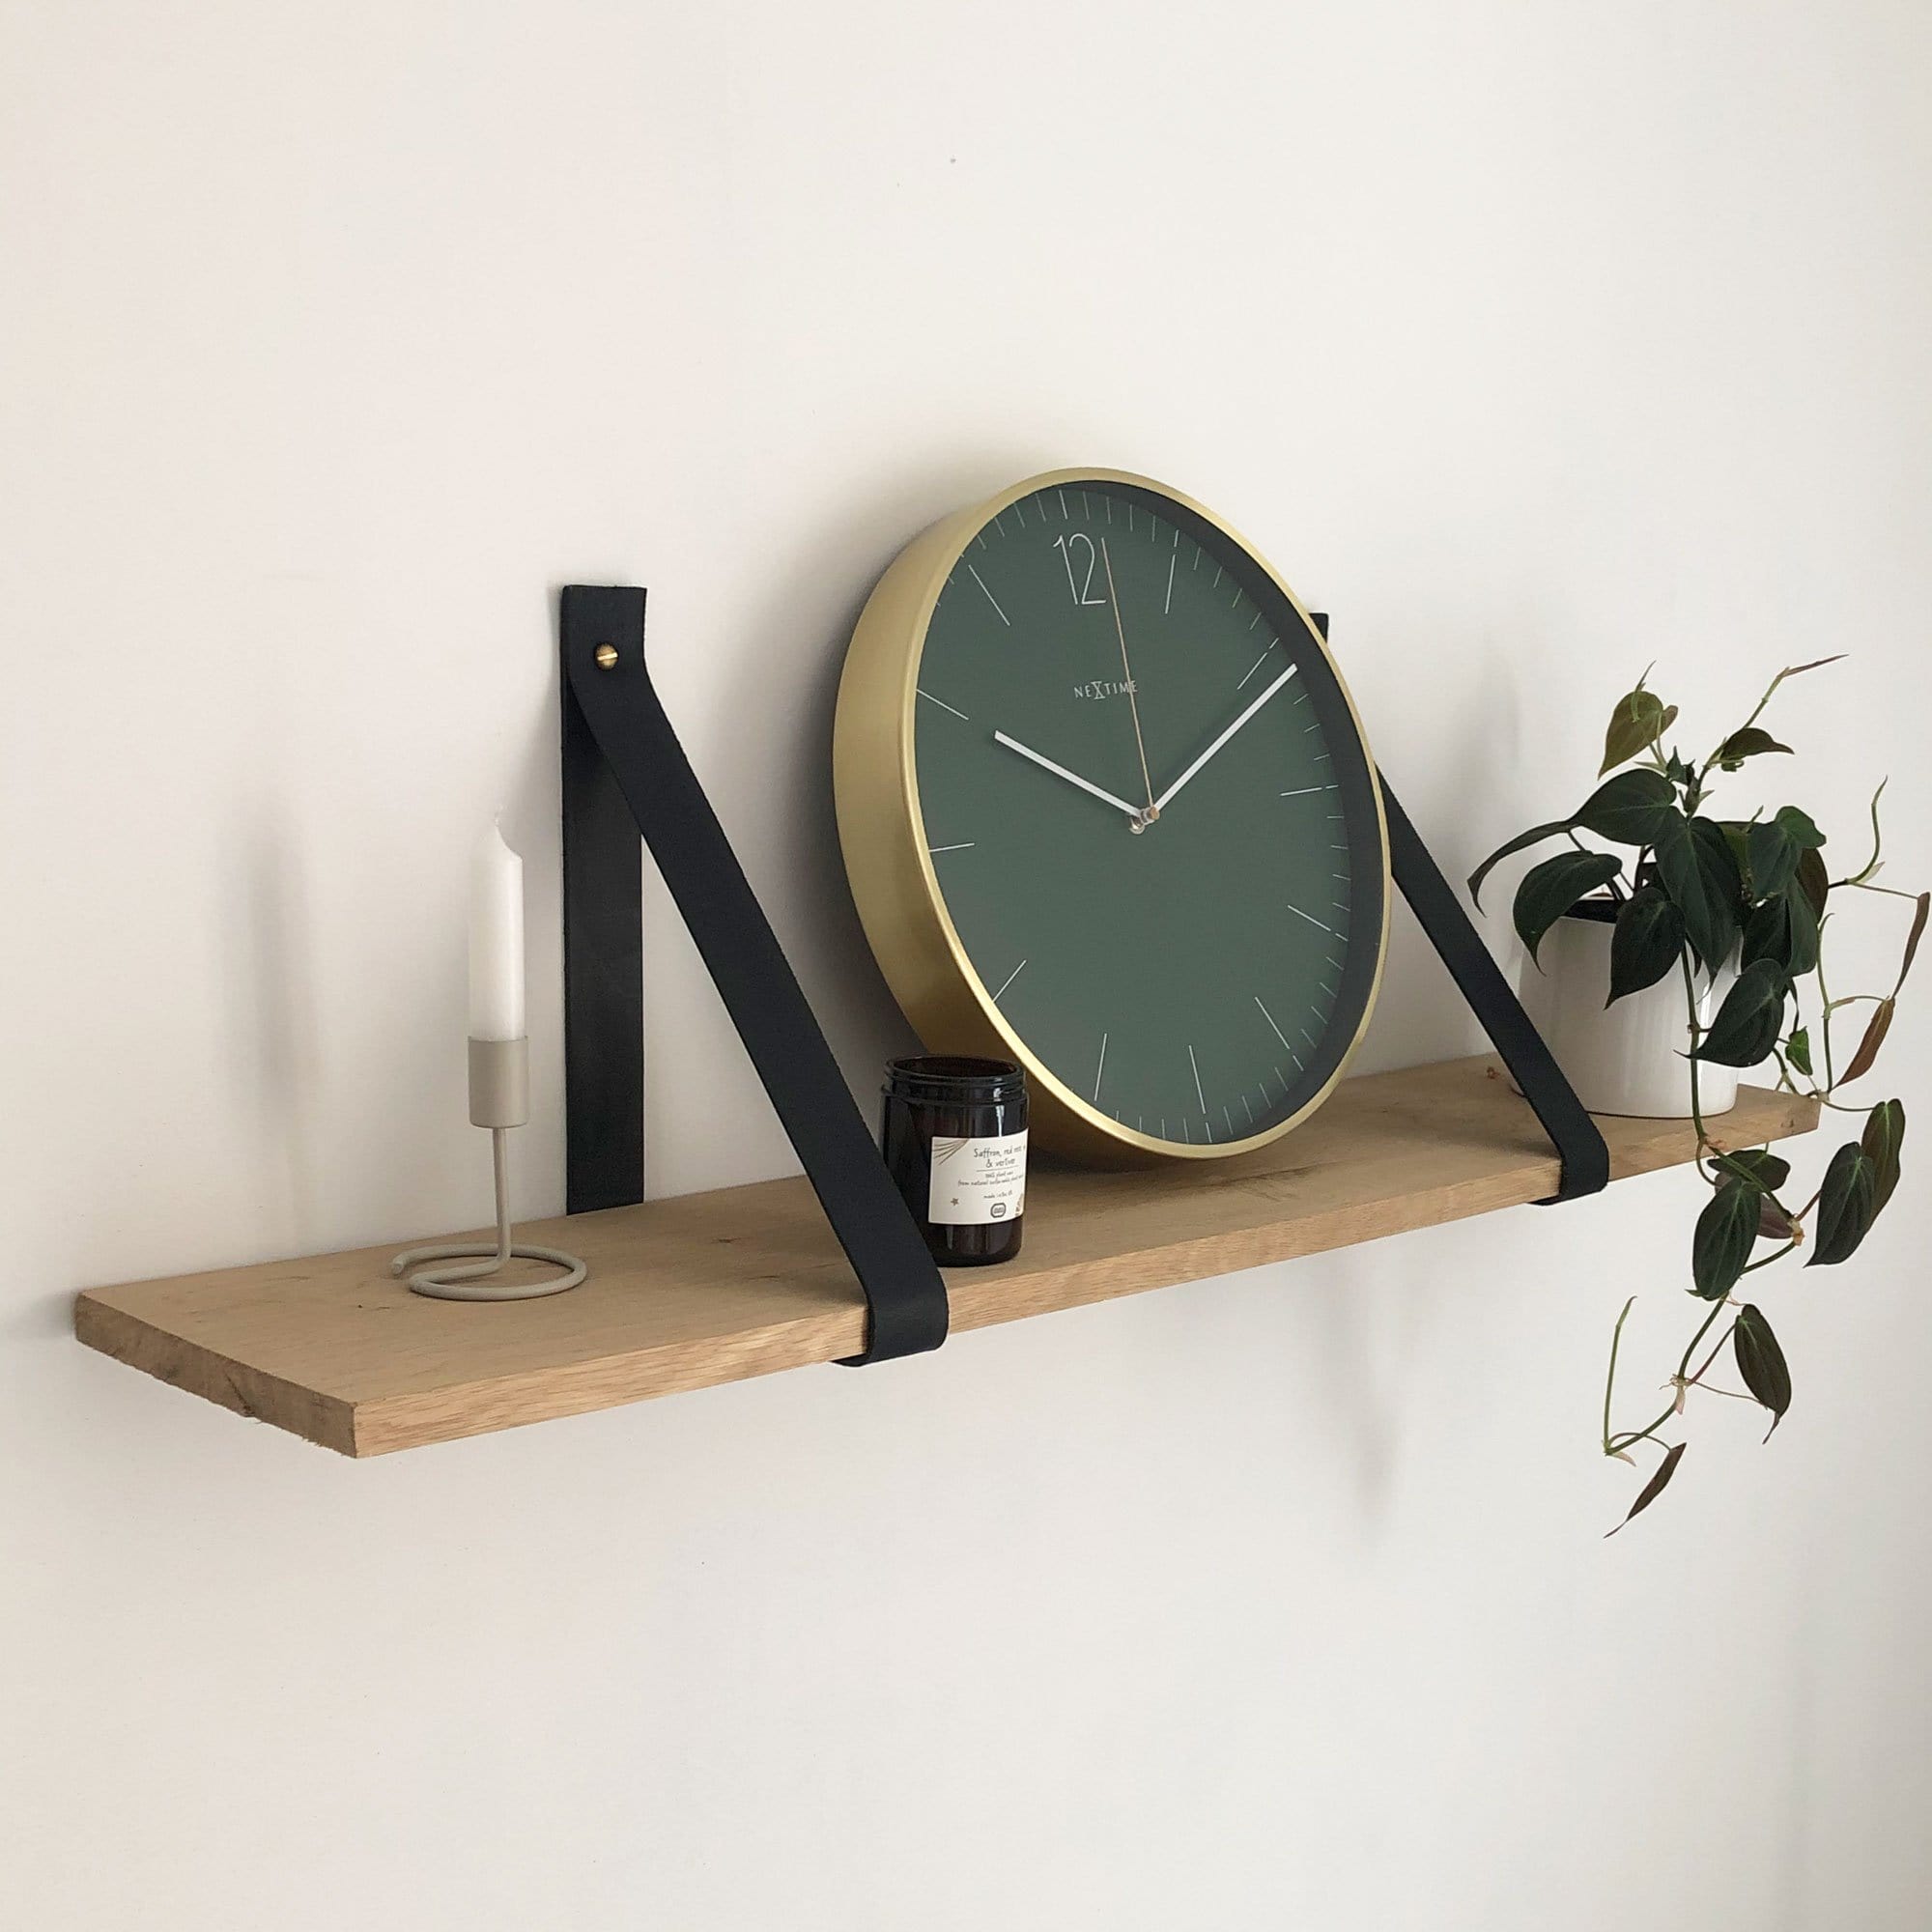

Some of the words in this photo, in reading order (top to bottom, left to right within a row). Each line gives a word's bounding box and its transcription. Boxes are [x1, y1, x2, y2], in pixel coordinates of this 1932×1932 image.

[1053, 533, 1106, 605] 12
[1074, 680, 1138, 699] NEXTIME
[985, 1158, 993, 1168] &
